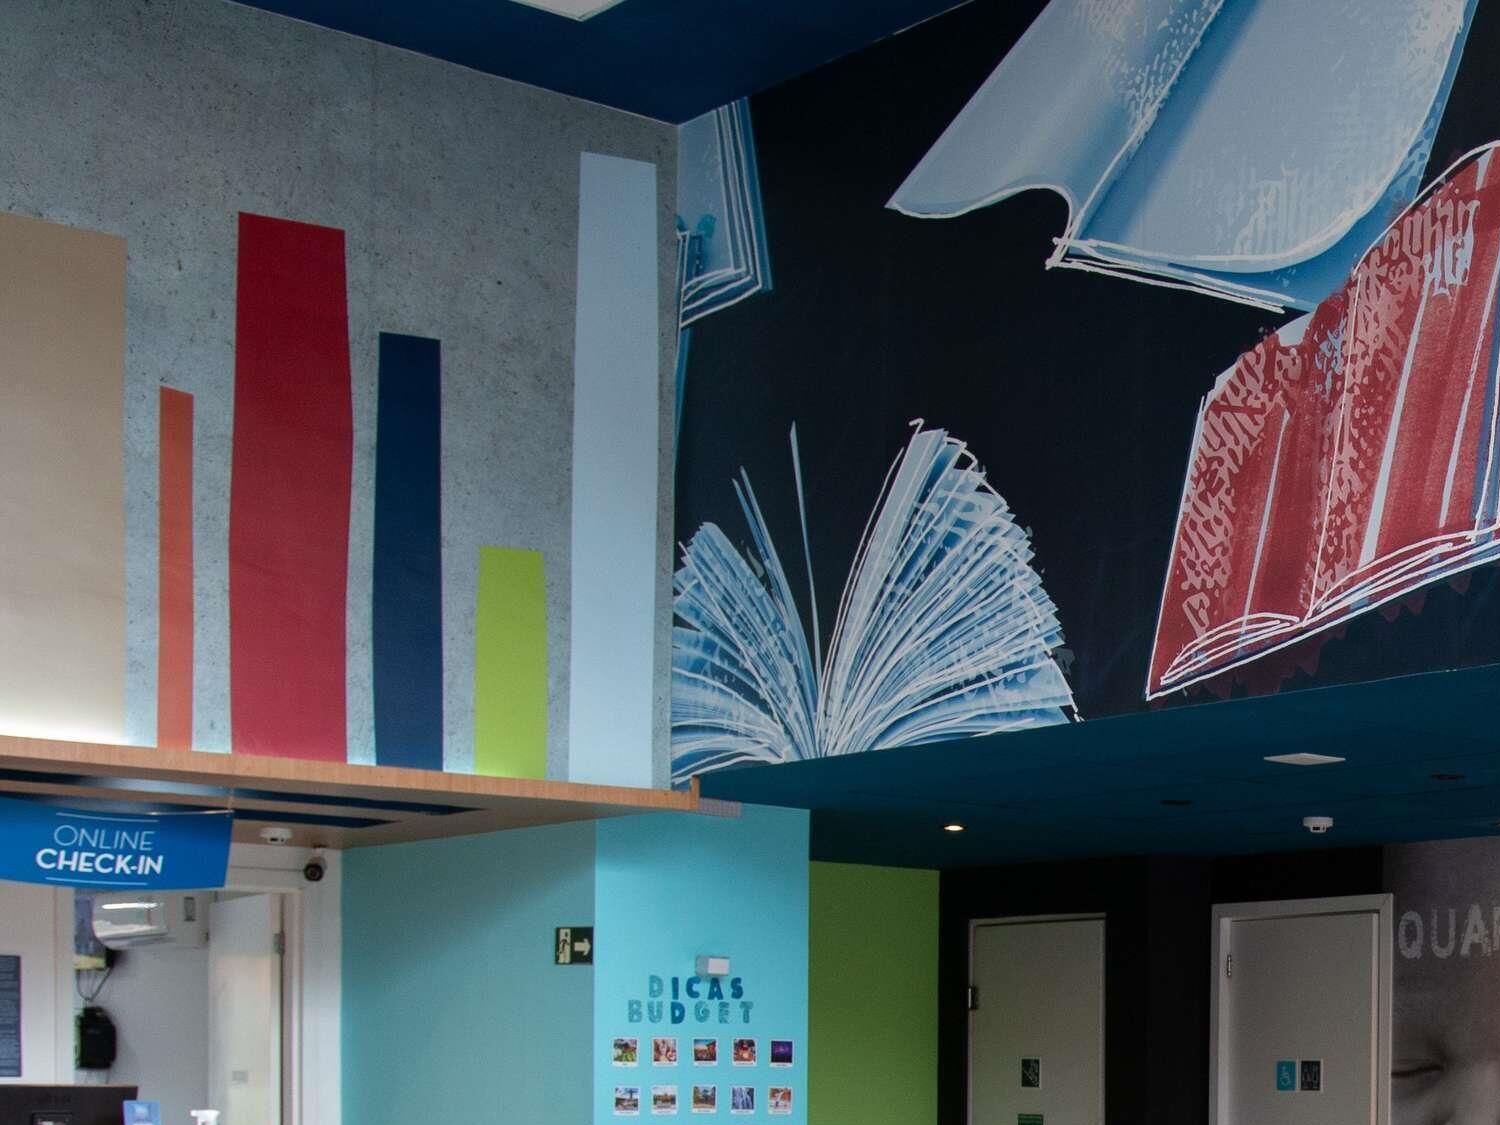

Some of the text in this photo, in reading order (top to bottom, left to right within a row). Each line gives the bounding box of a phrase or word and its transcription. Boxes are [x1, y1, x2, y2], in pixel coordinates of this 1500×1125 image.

[54, 824, 156, 851] ONLINE
[35, 848, 164, 875] CHECK-IN
[648, 974, 745, 1000] DICAS
[627, 1000, 754, 1025] BUDGET
